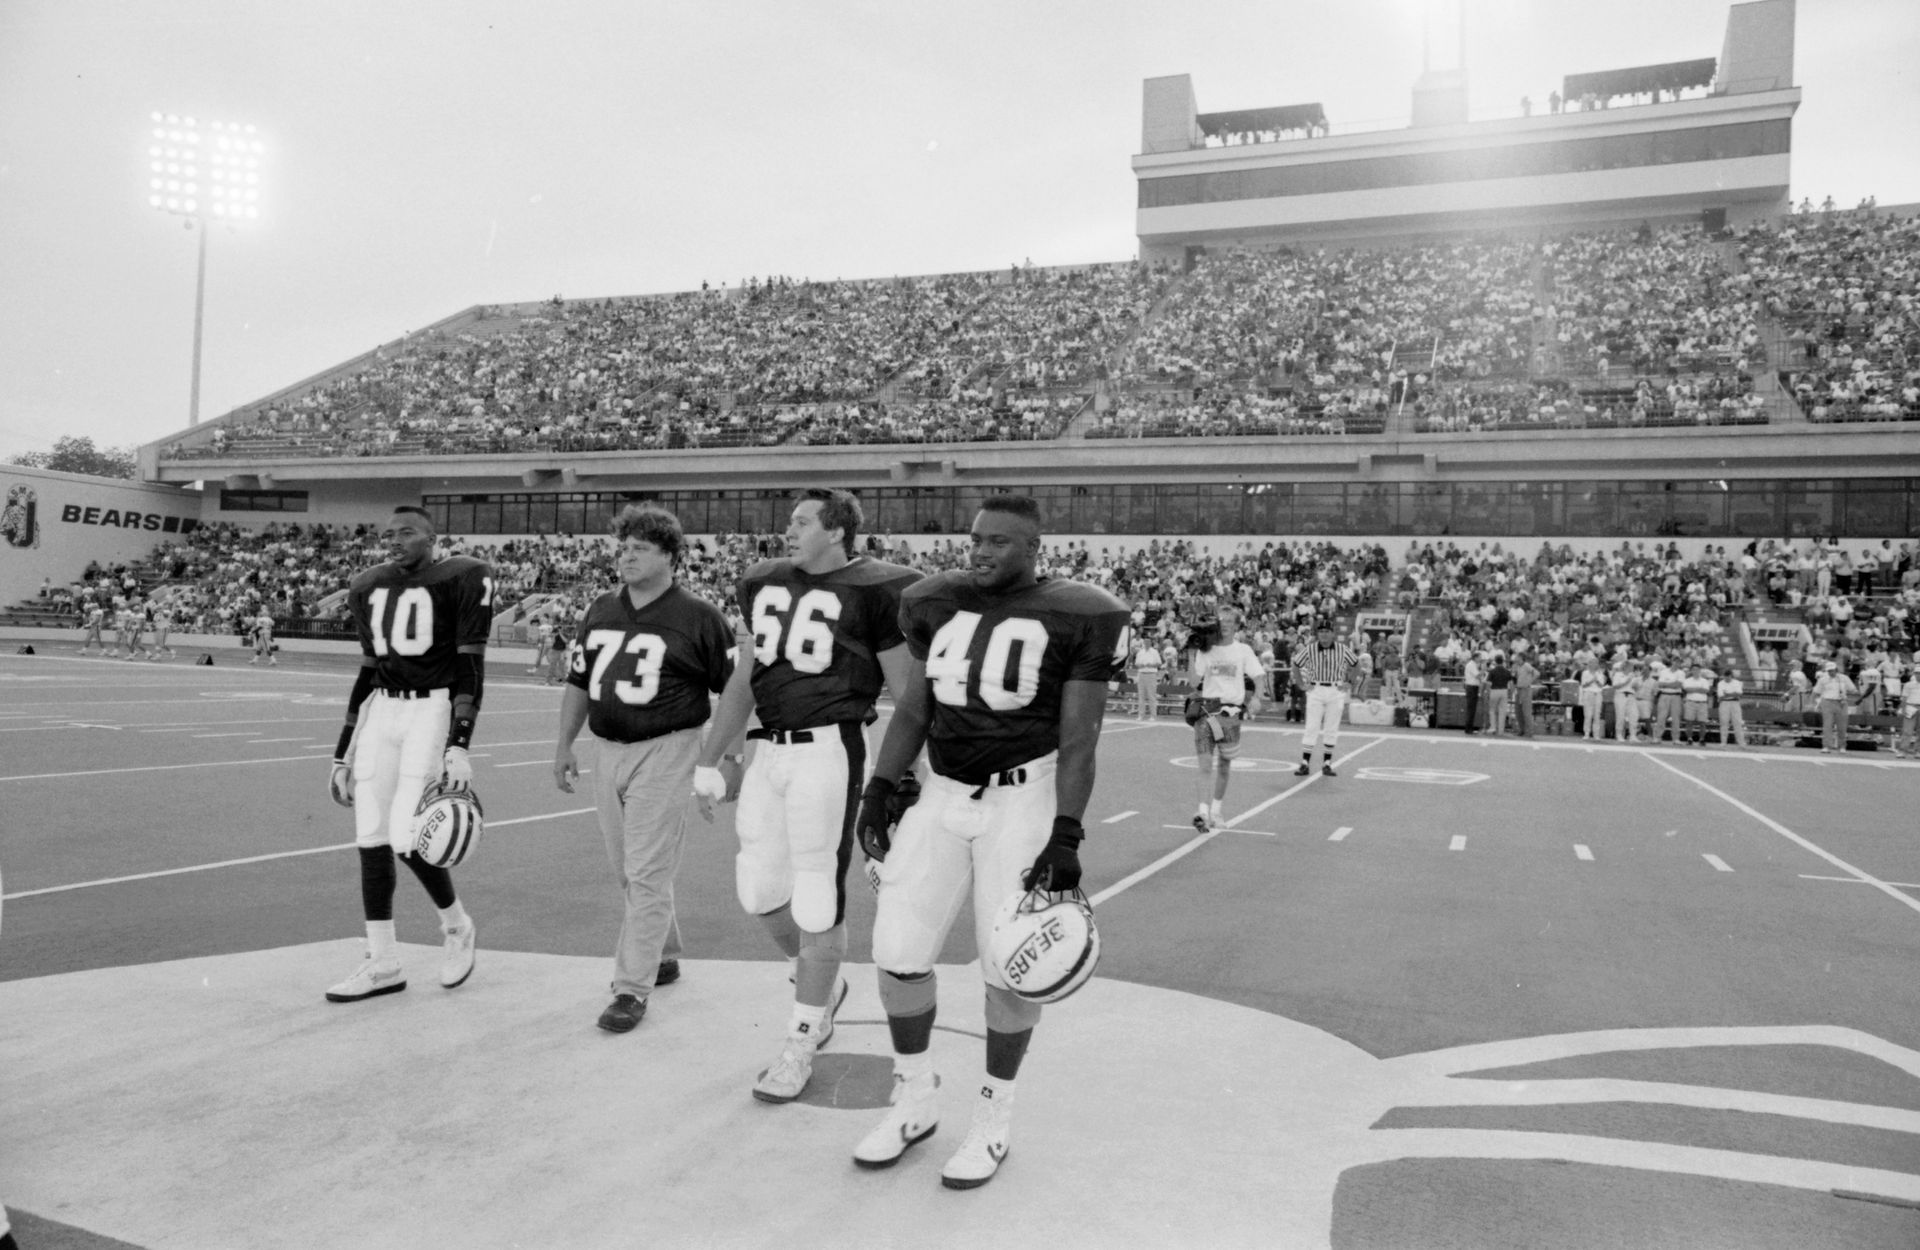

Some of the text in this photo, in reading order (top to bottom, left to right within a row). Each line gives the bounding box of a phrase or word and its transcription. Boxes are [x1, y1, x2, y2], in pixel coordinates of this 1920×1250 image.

[61, 504, 163, 531] BEARS
[368, 587, 434, 657] 10
[752, 585, 842, 674] 66
[586, 629, 668, 705] 73
[925, 610, 1049, 711] 40
